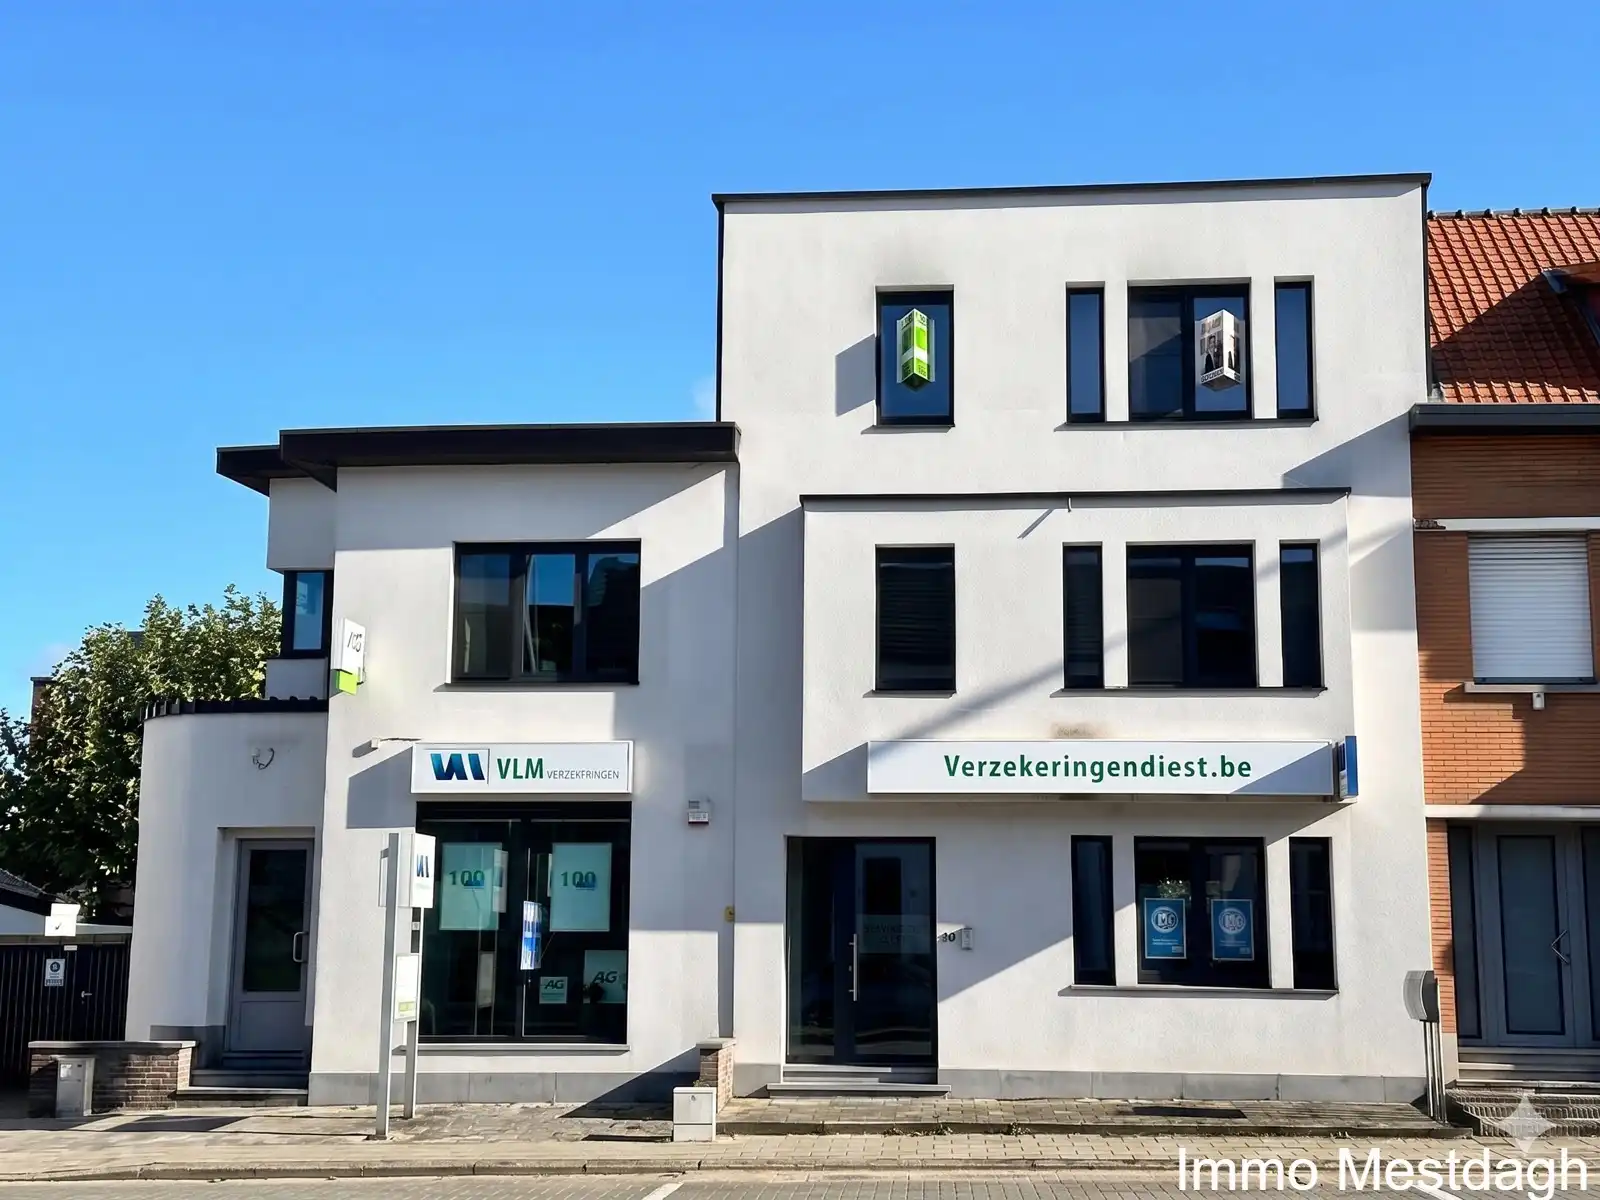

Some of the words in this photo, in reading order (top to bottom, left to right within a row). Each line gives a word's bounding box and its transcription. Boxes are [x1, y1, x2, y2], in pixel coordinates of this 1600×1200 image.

[497, 757, 544, 780] VLM
[943, 754, 1253, 783] Verzekeringendiest.be
[448, 869, 486, 887] 100
[560, 870, 597, 888] 100
[544, 979, 565, 990] AG
[592, 970, 618, 985] AG
